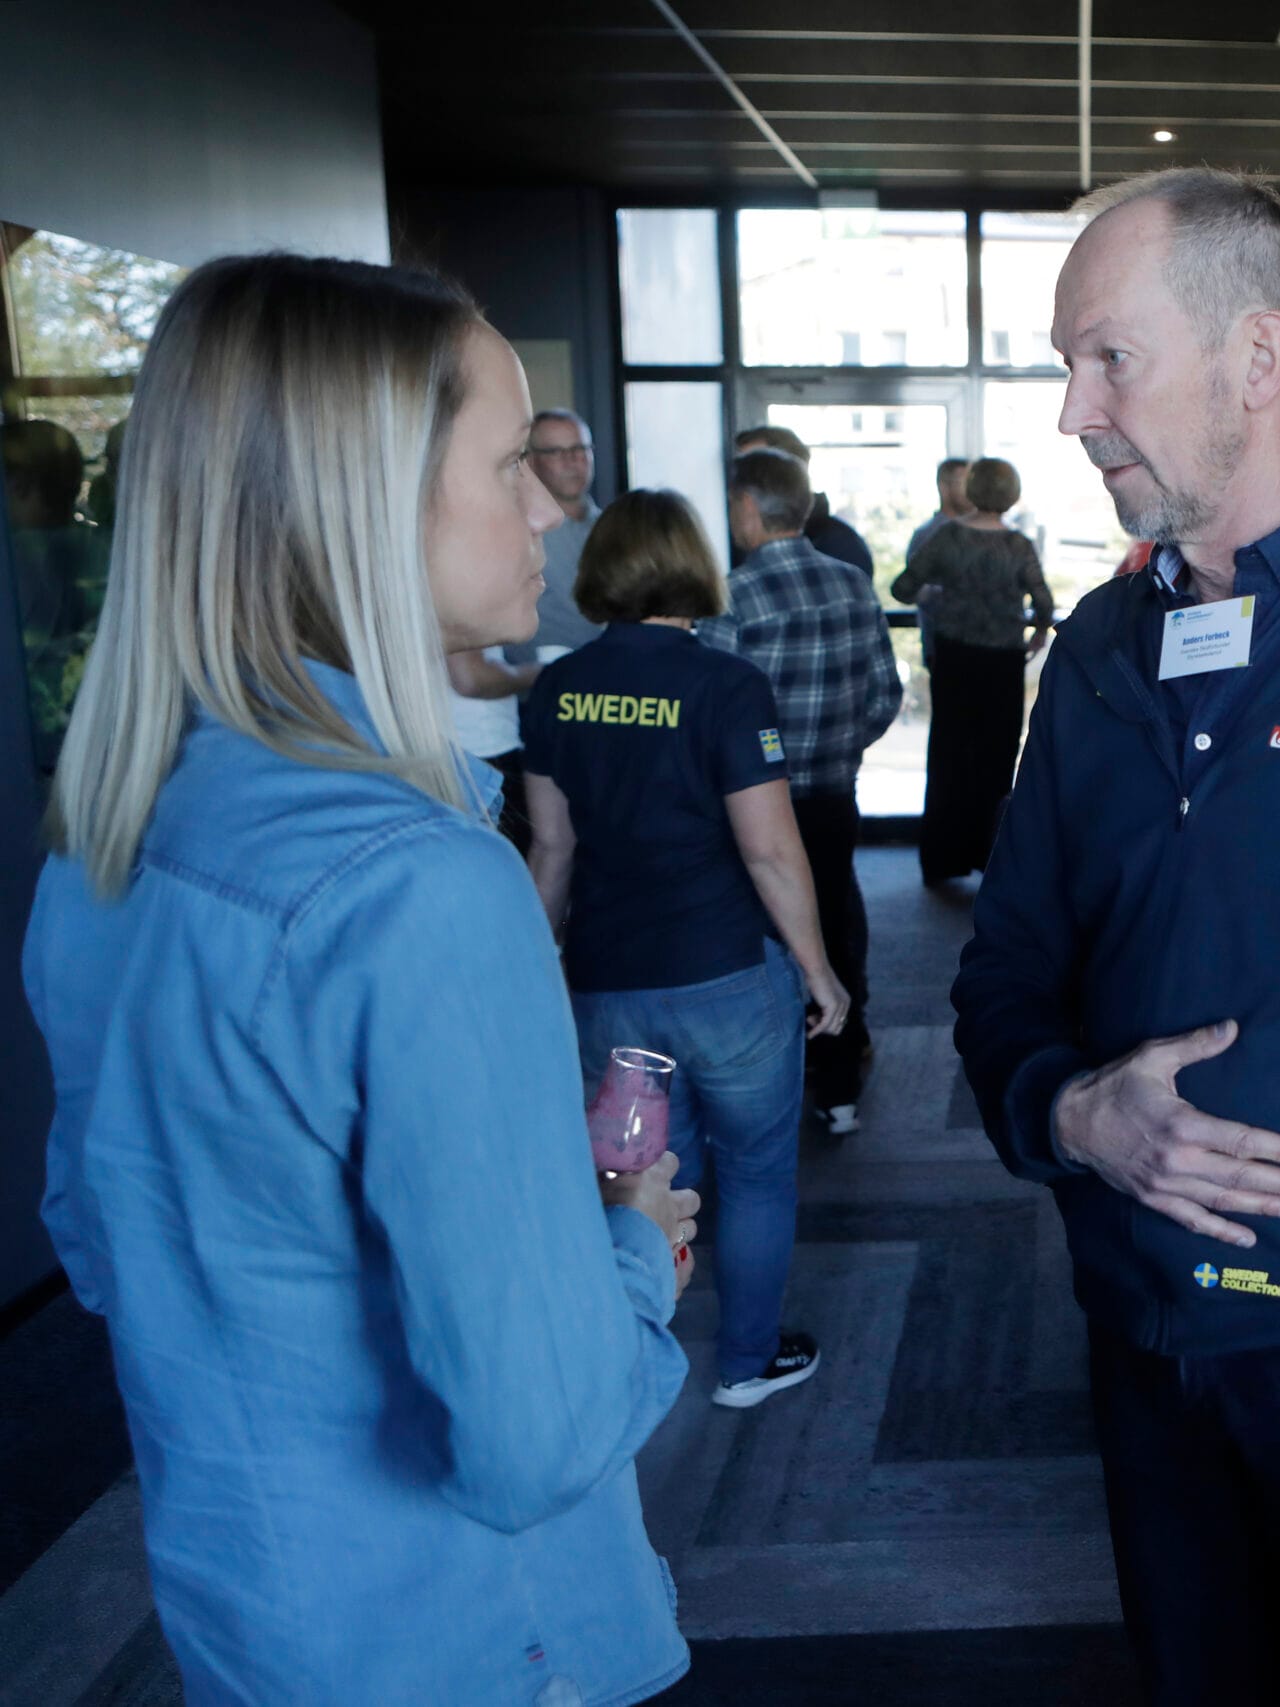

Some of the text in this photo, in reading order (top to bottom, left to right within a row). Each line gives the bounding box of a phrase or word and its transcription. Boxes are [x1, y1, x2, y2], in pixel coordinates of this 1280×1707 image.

[1182, 630, 1230, 646] Anders Forbeck
[557, 692, 681, 728] SWEDEN
[1222, 1267, 1269, 1283] SWEDEN
